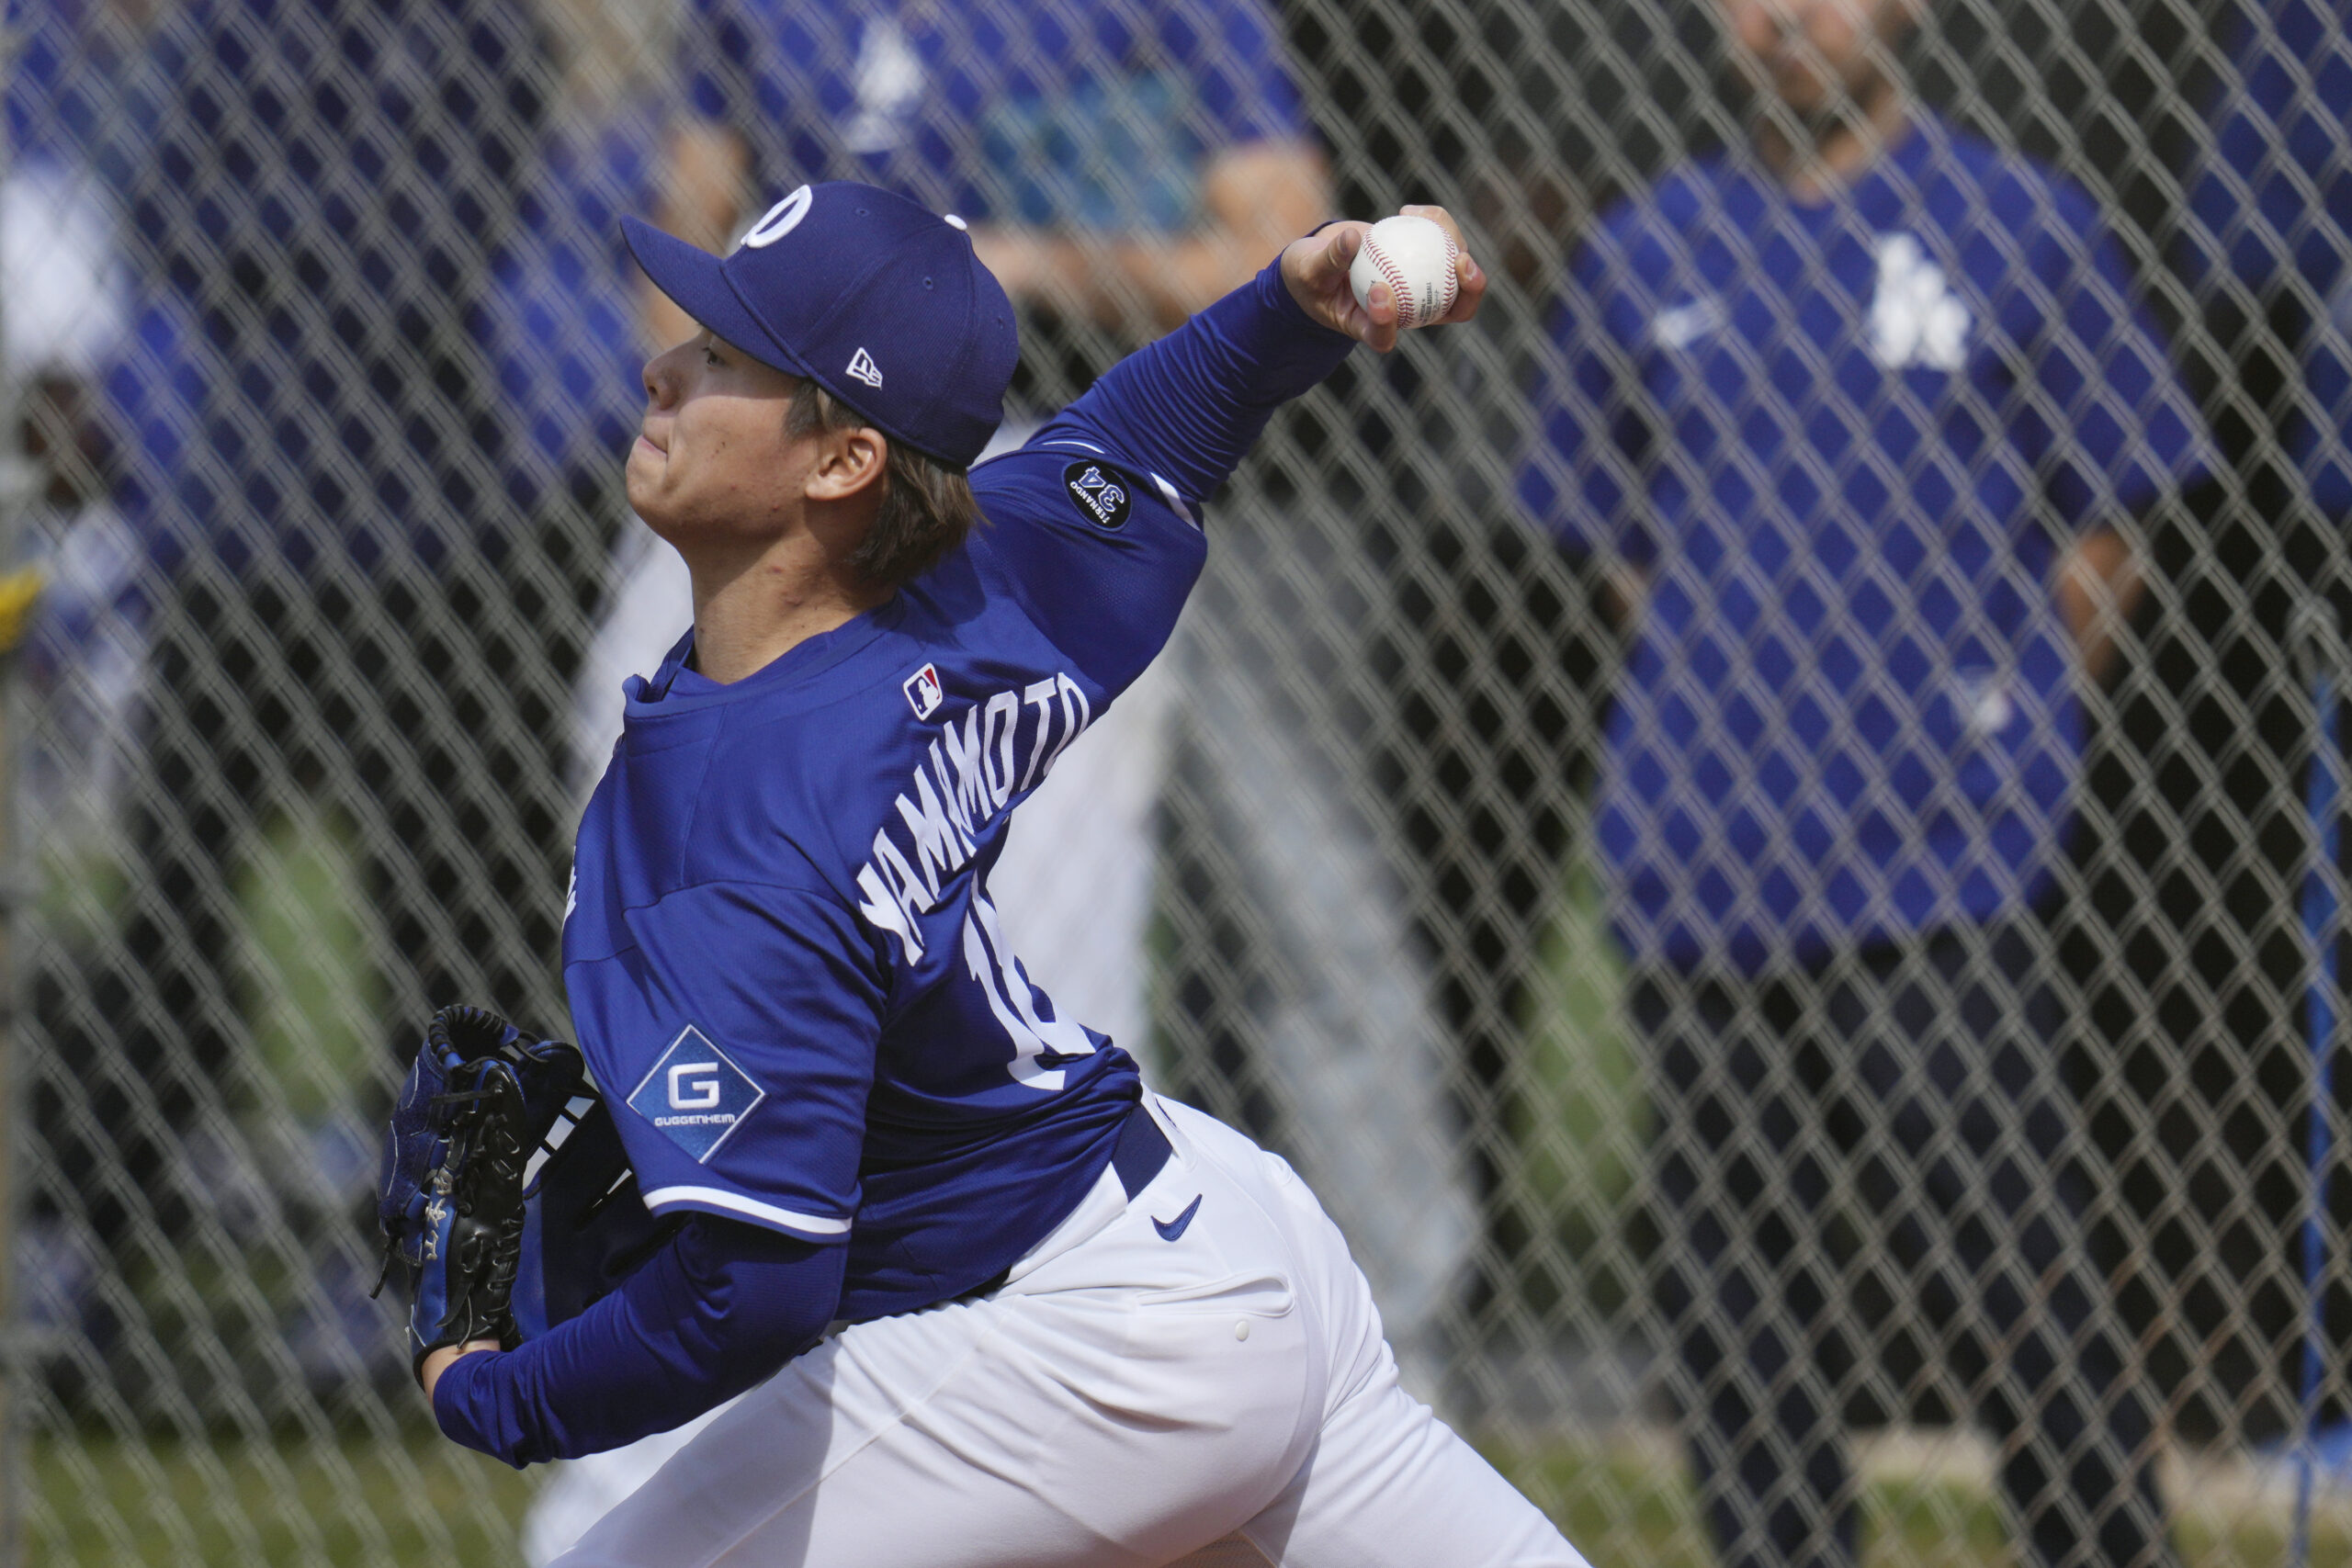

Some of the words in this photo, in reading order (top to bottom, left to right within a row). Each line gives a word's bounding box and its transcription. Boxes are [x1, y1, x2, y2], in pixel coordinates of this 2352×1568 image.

[1069, 481, 1110, 524] FERNANDO
[1078, 467, 1125, 513] 34
[856, 672, 1091, 967] YAMAMOTO
[667, 1062, 720, 1110] G
[654, 1113, 736, 1127] GUGGENHEIM
